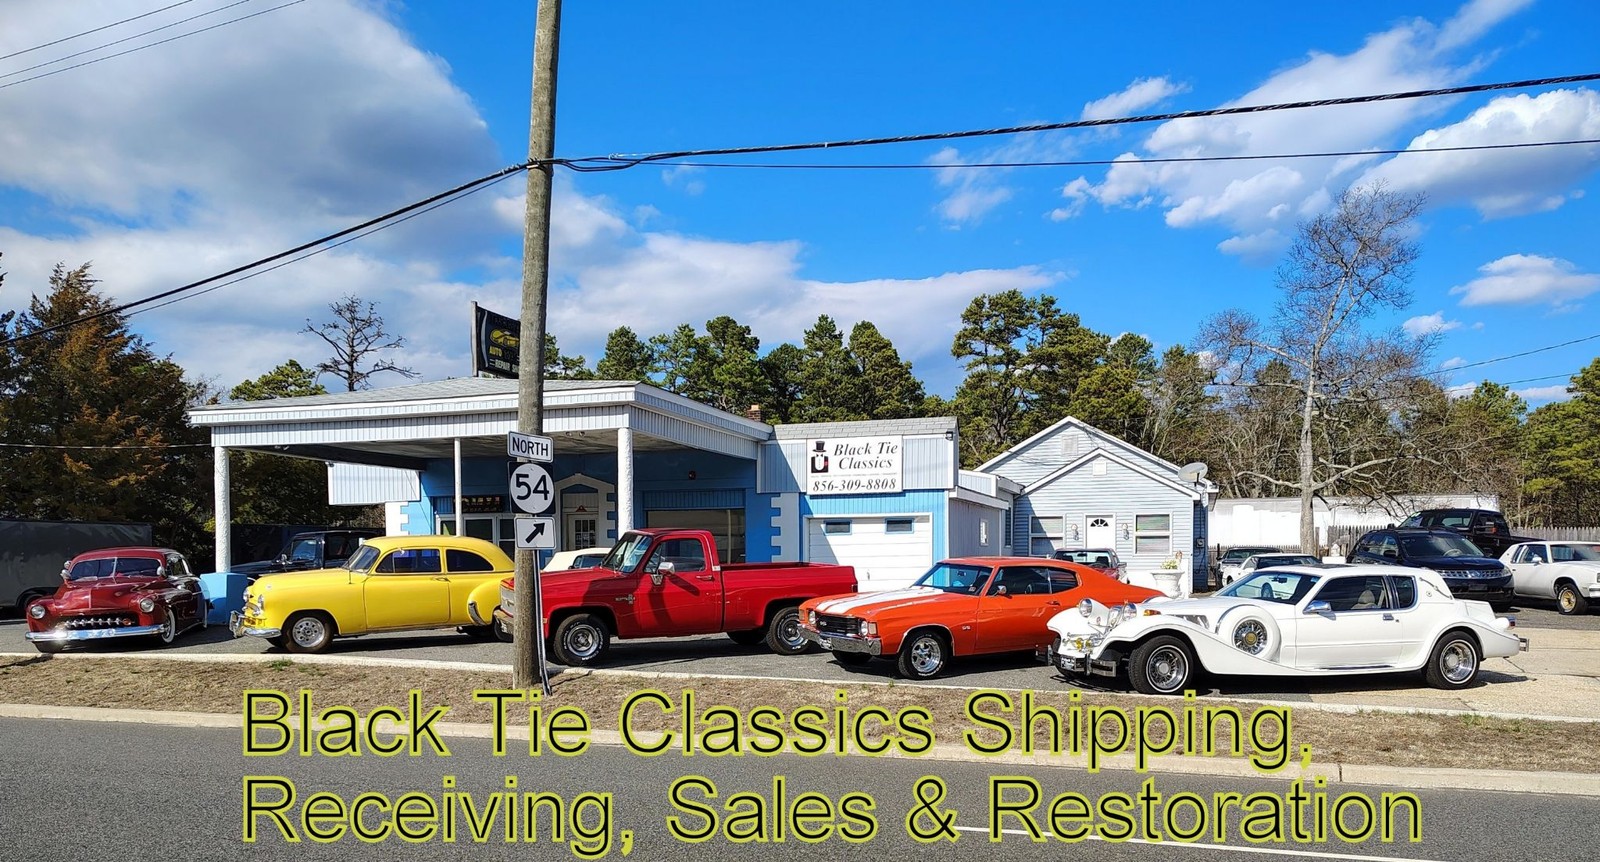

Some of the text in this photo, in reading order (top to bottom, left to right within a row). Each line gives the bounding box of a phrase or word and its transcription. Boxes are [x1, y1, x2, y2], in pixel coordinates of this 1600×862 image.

[512, 437, 549, 457] NORTH
[834, 442, 898, 456] Black Tie
[838, 456, 893, 470] Classics
[515, 473, 550, 501] 54
[812, 478, 897, 492] 856-309-8808
